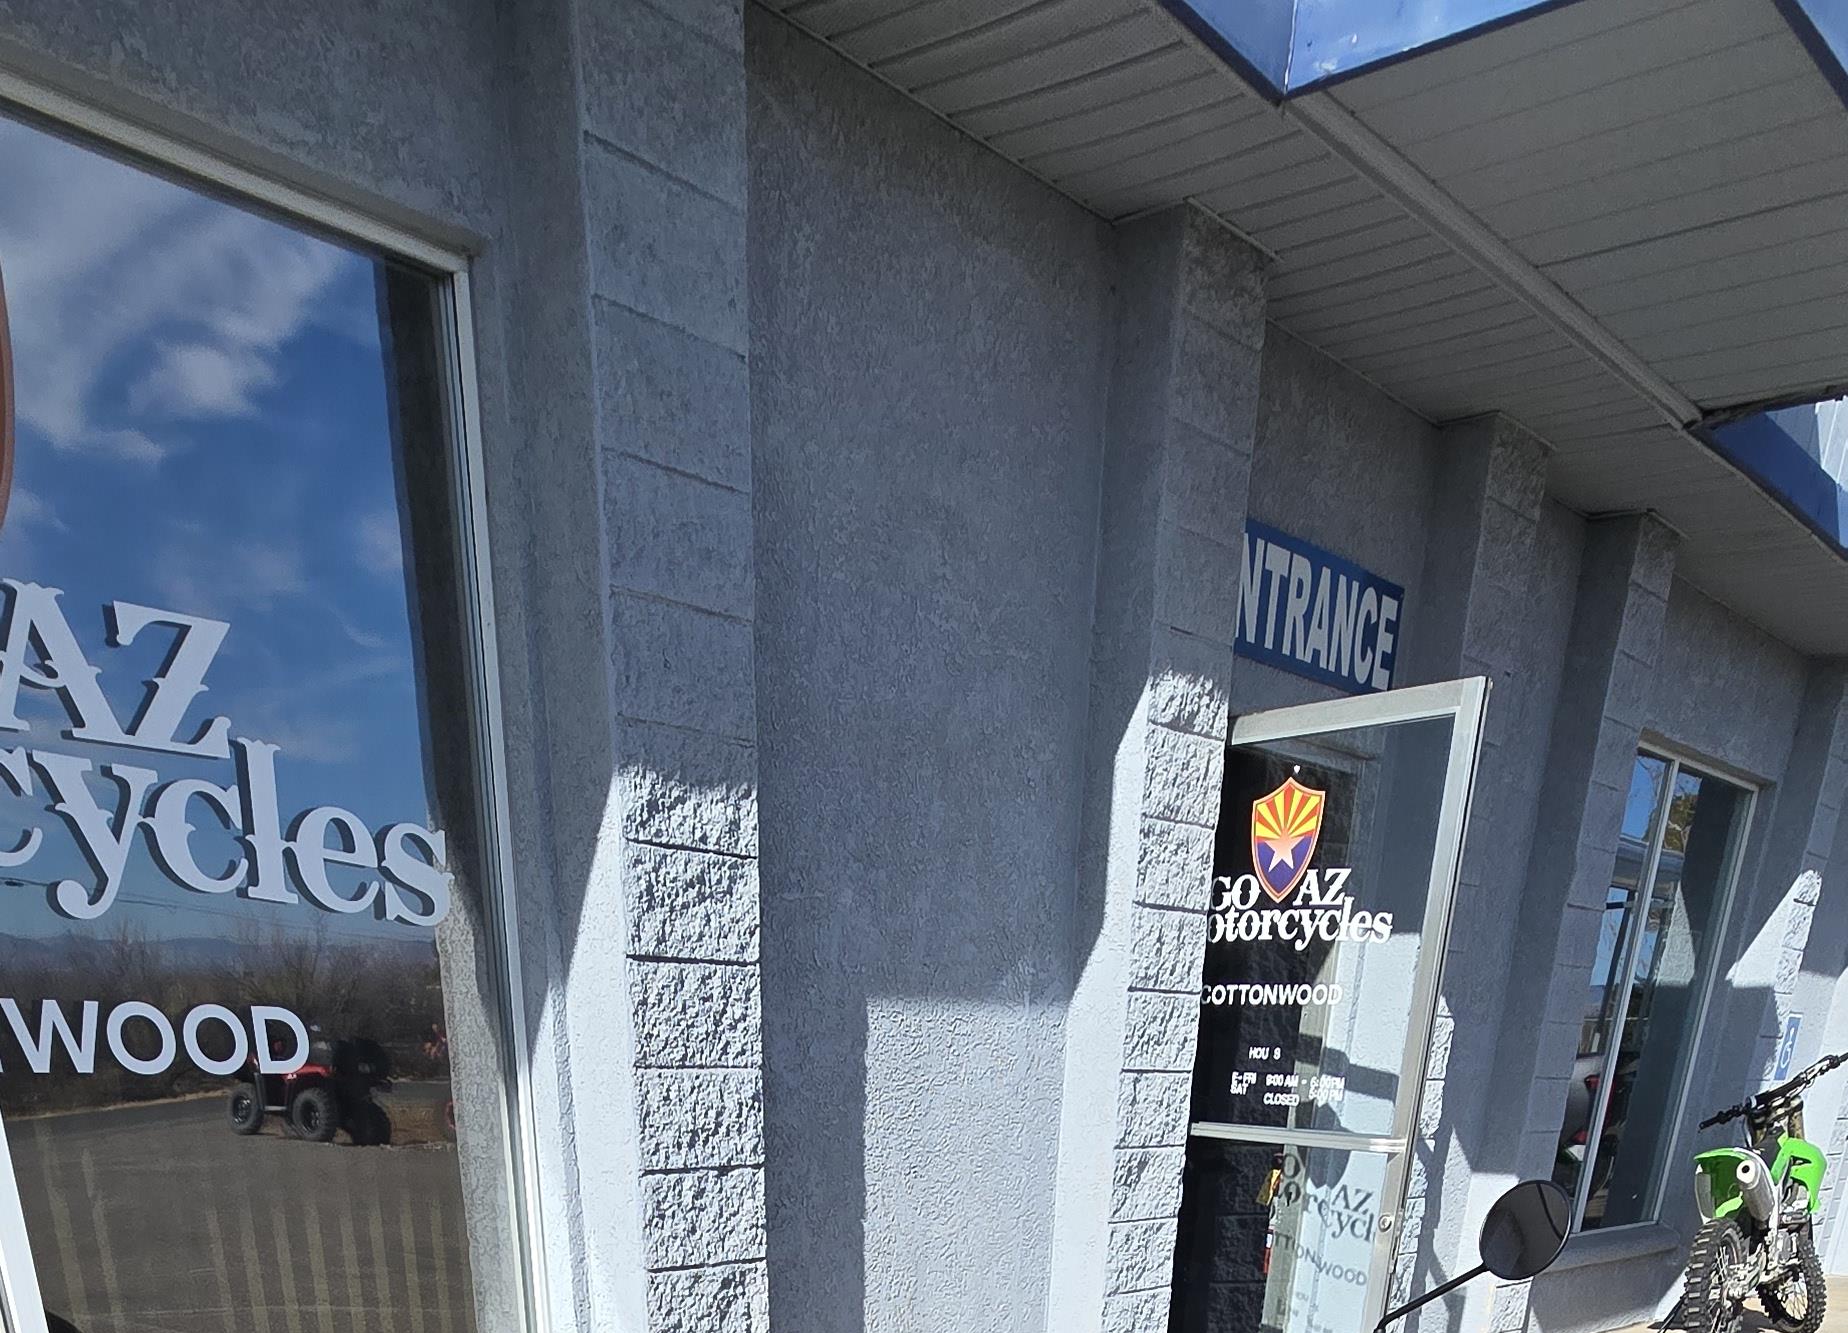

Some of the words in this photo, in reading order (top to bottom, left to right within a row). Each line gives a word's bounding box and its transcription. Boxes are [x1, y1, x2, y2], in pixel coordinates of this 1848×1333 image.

[1293, 868, 1352, 906] AZ
[1201, 984, 1343, 1006] COTTONWOOD
[0, 998, 310, 1076] WOOD
[1263, 1093, 1300, 1107] CLOSED
